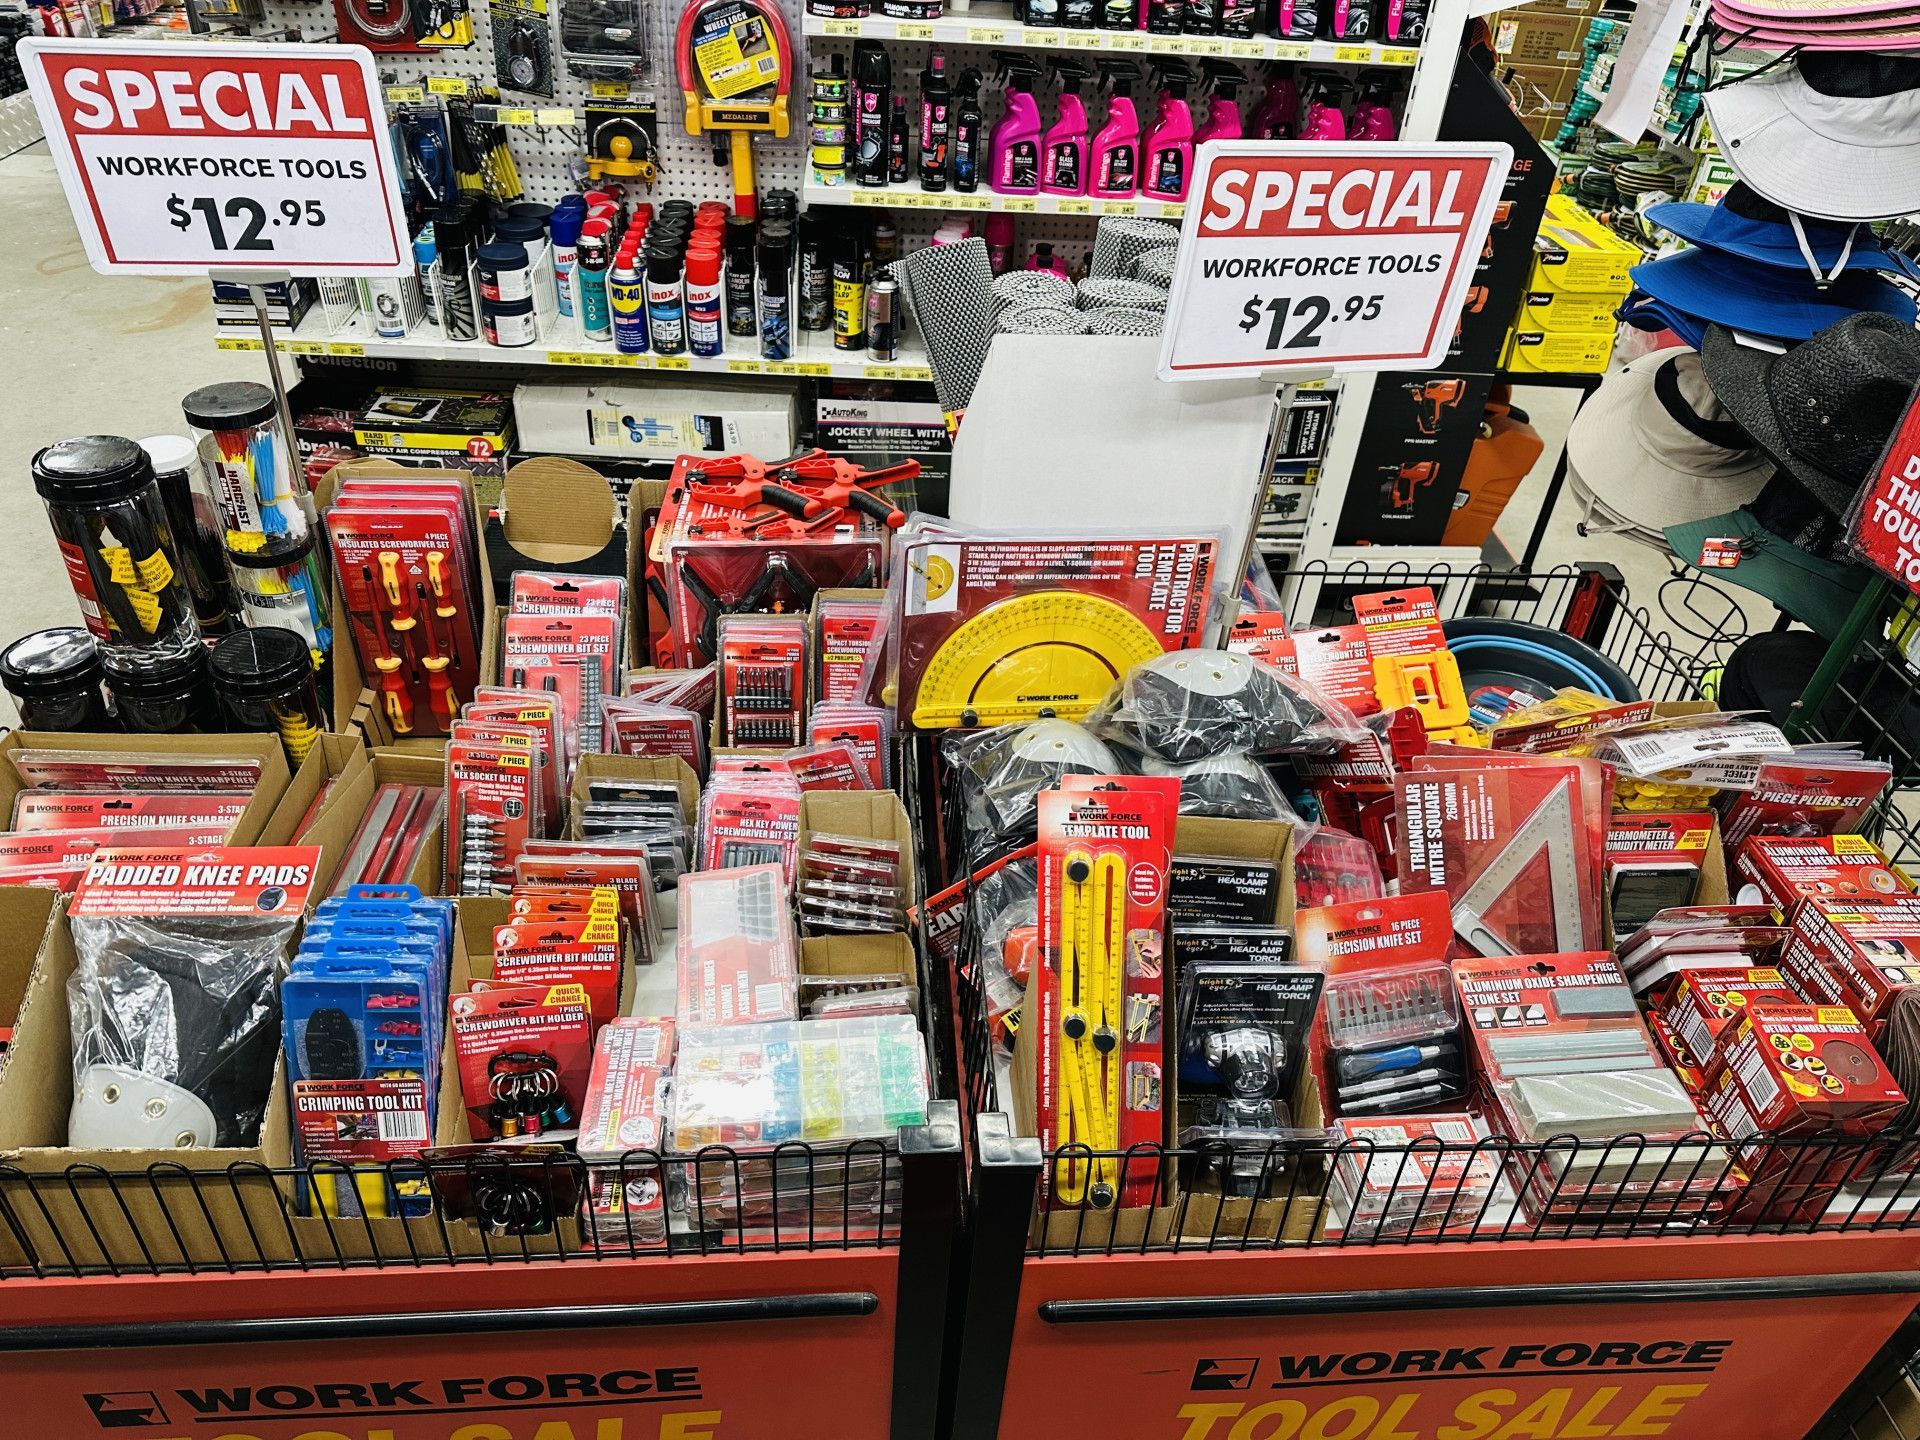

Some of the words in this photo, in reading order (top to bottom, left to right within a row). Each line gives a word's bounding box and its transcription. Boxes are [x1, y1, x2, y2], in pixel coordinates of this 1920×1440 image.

[704, 18, 726, 33] WHEEL
[728, 13, 748, 26] LOCK
[63, 67, 368, 133] SPECIAL
[722, 113, 757, 121] MEDALIST
[922, 104, 931, 148] Flamingo
[97, 156, 275, 179] WORKFORCE
[279, 158, 367, 179] TOOLS
[1002, 149, 1012, 184] Flamingo
[1045, 149, 1055, 183] Flamingo
[1099, 153, 1110, 187] Flamingo
[1148, 153, 1160, 187] Flamingo
[1202, 169, 1465, 231] SPECIAL
[166, 193, 326, 251] $12.95
[1203, 257, 1359, 279] WORKFORCE
[1367, 253, 1442, 275] TOOLS
[611, 287, 640, 302] WD-40
[651, 289, 674, 300] inox
[689, 290, 711, 301] inox
[1239, 295, 1384, 350] $12.95
[306, 355, 397, 371] Collection
[1303, 411, 1314, 435] BOTTLE
[1308, 413, 1320, 450] HYDRAULIC
[828, 427, 876, 438] JOCKEY
[878, 428, 914, 438] WHEEL
[917, 429, 945, 439] WITH
[410, 448, 460, 456] COMPRESSOR
[472, 441, 489, 456] 72
[1270, 476, 1294, 484] JACK
[228, 470, 250, 525] HARDFAST
[437, 541, 449, 549] SET
[1135, 546, 1157, 579] TOOL
[1149, 543, 1168, 610] TEMPLATE
[1197, 555, 1209, 595] WORK
[1165, 543, 1196, 634] PROTRACTOR
[516, 604, 580, 614] SCREWDRIVER
[1187, 597, 1201, 633] FORCE
[1360, 614, 1392, 625] BATTERY
[1394, 611, 1420, 621] MOUNT
[1422, 609, 1435, 617] SET
[508, 644, 574, 653] SCREWDRIVER
[576, 644, 591, 653] BIT
[593, 643, 609, 653] SET
[107, 775, 163, 783] PRECISION
[165, 775, 196, 783] KNIFE
[198, 776, 257, 784] SHARPENER
[454, 772, 469, 780] HEX
[470, 773, 498, 781] SOCKET
[499, 774, 511, 782] BIT
[512, 775, 526, 783] SET
[1445, 783, 1458, 820] 260MM
[1751, 790, 1760, 801] 3
[1762, 792, 1798, 805] PIECE
[1800, 795, 1839, 807] PLIERS
[1841, 796, 1865, 807] SET
[1111, 813, 1142, 821] FORCE
[1424, 783, 1442, 838] SQUARE
[100, 815, 156, 826] PRECISION
[740, 819, 754, 827] HEX
[755, 820, 769, 828] KEY
[771, 821, 798, 831] POWER
[1405, 783, 1425, 872] TRIANGULAR
[188, 835, 223, 845] 3-STAGE
[713, 827, 768, 838] SCREWDRIVER
[770, 829, 782, 839] BIT
[784, 831, 797, 840] SET
[1061, 824, 1118, 838] TEMPLATE
[1120, 826, 1151, 839] TOOL
[1763, 847, 1829, 856] ALUMINIUM
[1772, 857, 1805, 866] OXIDE
[1806, 856, 1842, 865] EMERY
[1843, 855, 1880, 865] CLOTH
[1427, 840, 1445, 885] MITRE
[84, 865, 181, 886] PADDED
[183, 865, 243, 886] KNEE
[246, 865, 309, 886] PADS
[1217, 877, 1267, 886] HEADLAMP
[1236, 887, 1266, 895] TORCH
[1806, 902, 1827, 925] DISCS
[1826, 906, 1857, 914] WHITE
[593, 924, 614, 932] QUICK
[1391, 922, 1399, 931] 16
[1400, 919, 1420, 930] PIECE
[1800, 909, 1820, 933] OXIDE
[587, 932, 614, 941] CHANGE
[1327, 937, 1375, 956] PRECISION
[1377, 933, 1402, 950] KNIFE
[1404, 931, 1422, 945] SET
[1823, 921, 1854, 960] SANDING
[1230, 946, 1282, 954] HEADLAMP
[1795, 937, 1815, 960] DISCS
[1819, 931, 1856, 974] ALUMINIUM
[497, 954, 563, 967] SCREWDRIVER
[565, 953, 581, 963] BIT
[582, 952, 615, 962] HOLDER
[1463, 979, 1522, 993] ALUMINIUM
[1524, 976, 1555, 989] OXIDE
[1557, 973, 1622, 987] SHARPENING
[1812, 957, 1843, 995] SANDING
[1854, 969, 1878, 1000] WHITE
[555, 987, 581, 995] QUICK
[1700, 983, 1728, 991] DETAIL
[1758, 982, 1786, 990] SHEETS
[550, 995, 582, 1003] CHANGE
[1466, 993, 1498, 1005] STONE
[1500, 992, 1521, 1003] SET
[457, 1021, 527, 1033] SCREWDRIVER
[547, 1013, 584, 1023] HOLDER
[1763, 1025, 1793, 1033] DETAIL
[1795, 1025, 1827, 1033] SANDER
[1829, 1025, 1860, 1033] SHEETS
[298, 1096, 365, 1112] CRIMPING
[366, 1096, 400, 1110] TOOL
[402, 1095, 423, 1109] KIT
[1280, 1347, 1494, 1381] WORK
[1499, 1340, 1734, 1370] FORCE
[176, 1379, 438, 1413] WORK
[441, 1366, 700, 1405] FORCE
[1175, 1393, 1421, 1440] TOOL
[1436, 1384, 1708, 1440] SALE
